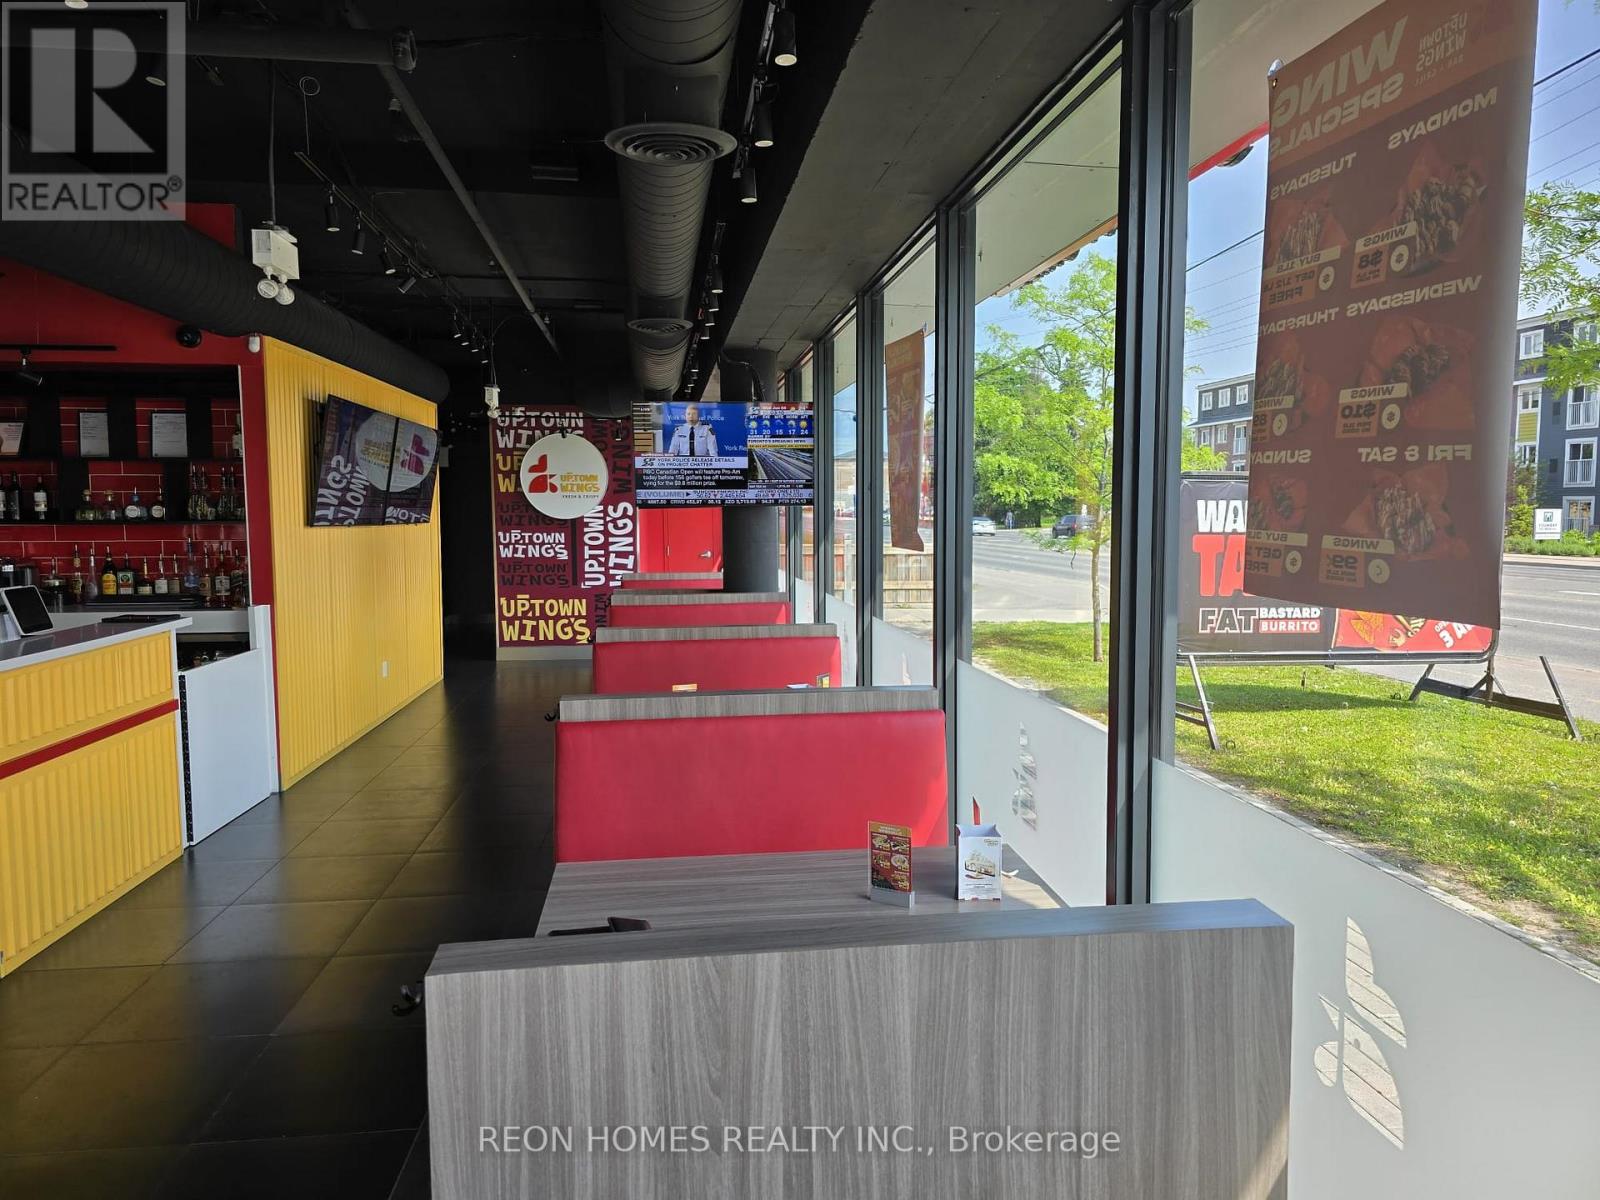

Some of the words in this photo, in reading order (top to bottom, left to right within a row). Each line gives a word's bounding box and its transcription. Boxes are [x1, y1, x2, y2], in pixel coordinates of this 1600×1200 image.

[497, 407, 584, 427] UPTOWN
[560, 472, 598, 483] UPTOWN
[498, 530, 565, 544] UPTOWN
[581, 505, 606, 588] UPTOWN
[500, 562, 567, 574] UPTOWN
[500, 594, 587, 617] UPTOWN
[1260, 607, 1321, 619] BASTARD
[1199, 607, 1260, 633] FAT
[1260, 620, 1320, 631] BURRITO
[1439, 630, 1455, 649] 3
